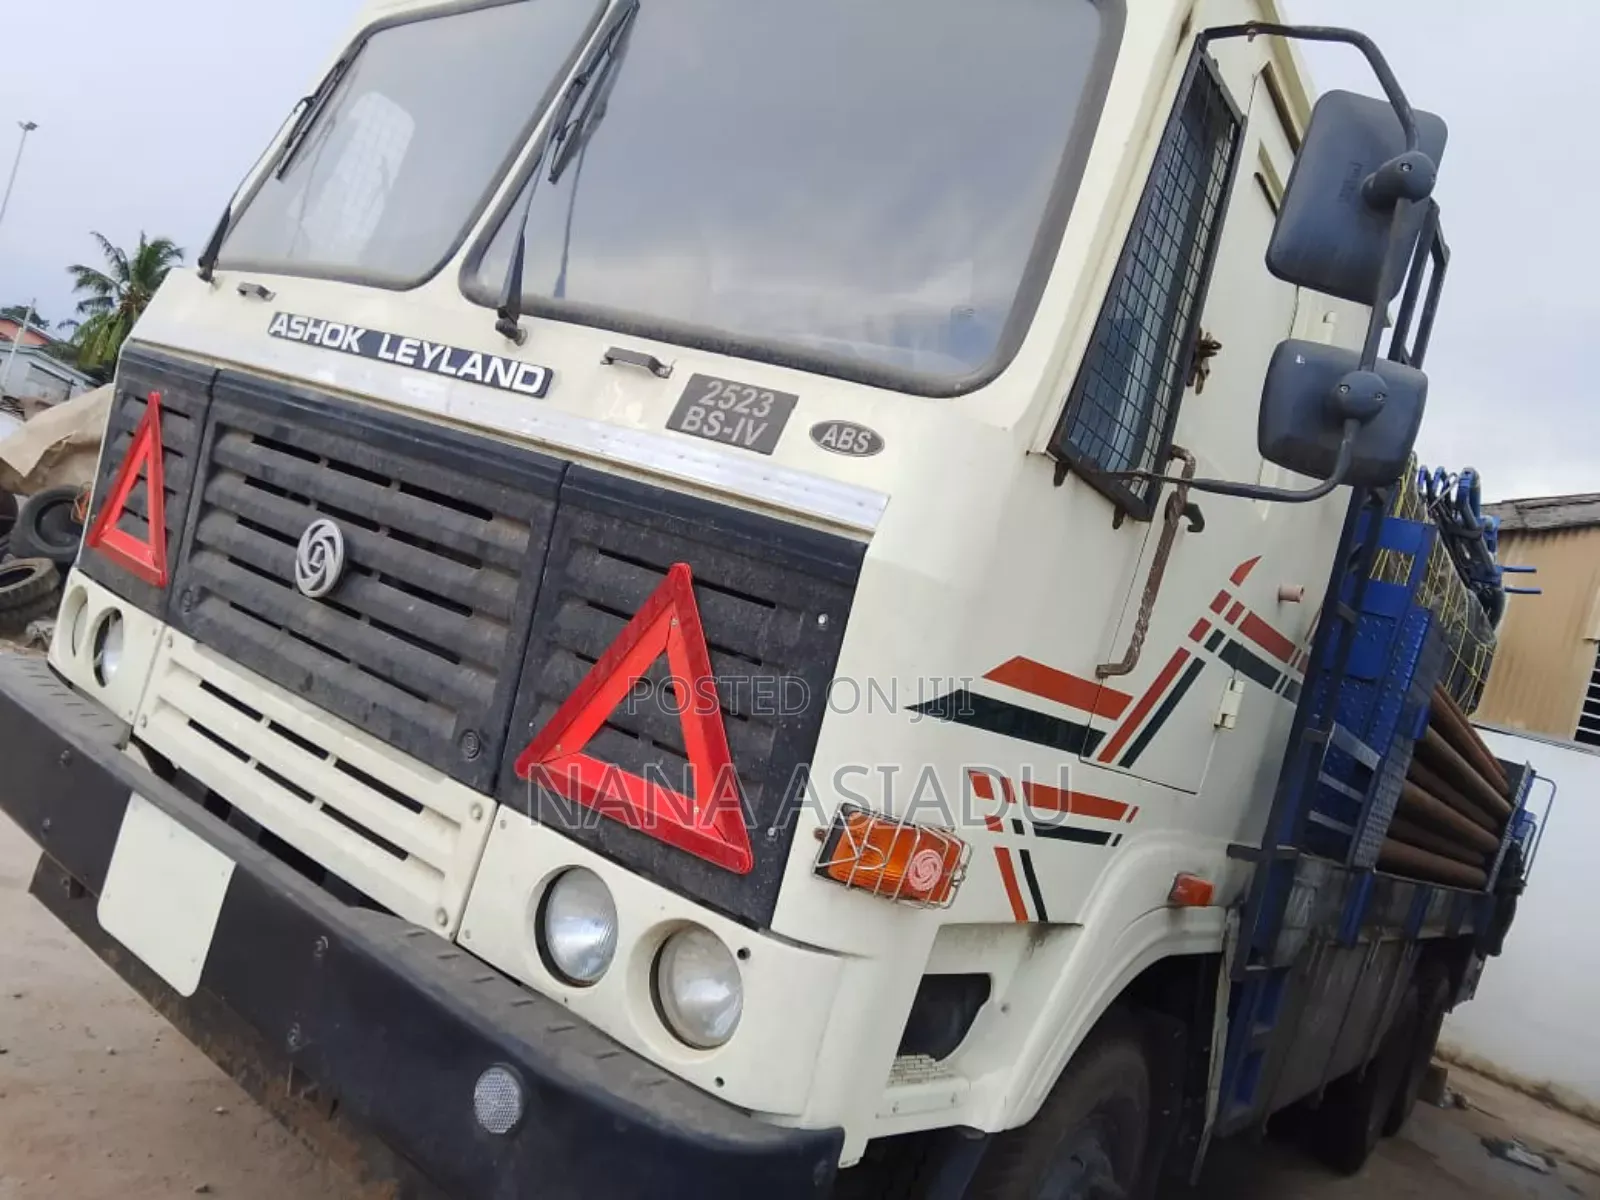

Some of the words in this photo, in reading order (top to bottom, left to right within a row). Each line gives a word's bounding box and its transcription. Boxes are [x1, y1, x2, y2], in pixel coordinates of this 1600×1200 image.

[269, 313, 366, 353] ASHOK
[378, 333, 546, 394] LEYLAND
[699, 381, 775, 418] 2523
[680, 405, 769, 446] BS-IV
[820, 424, 872, 452] ABS
